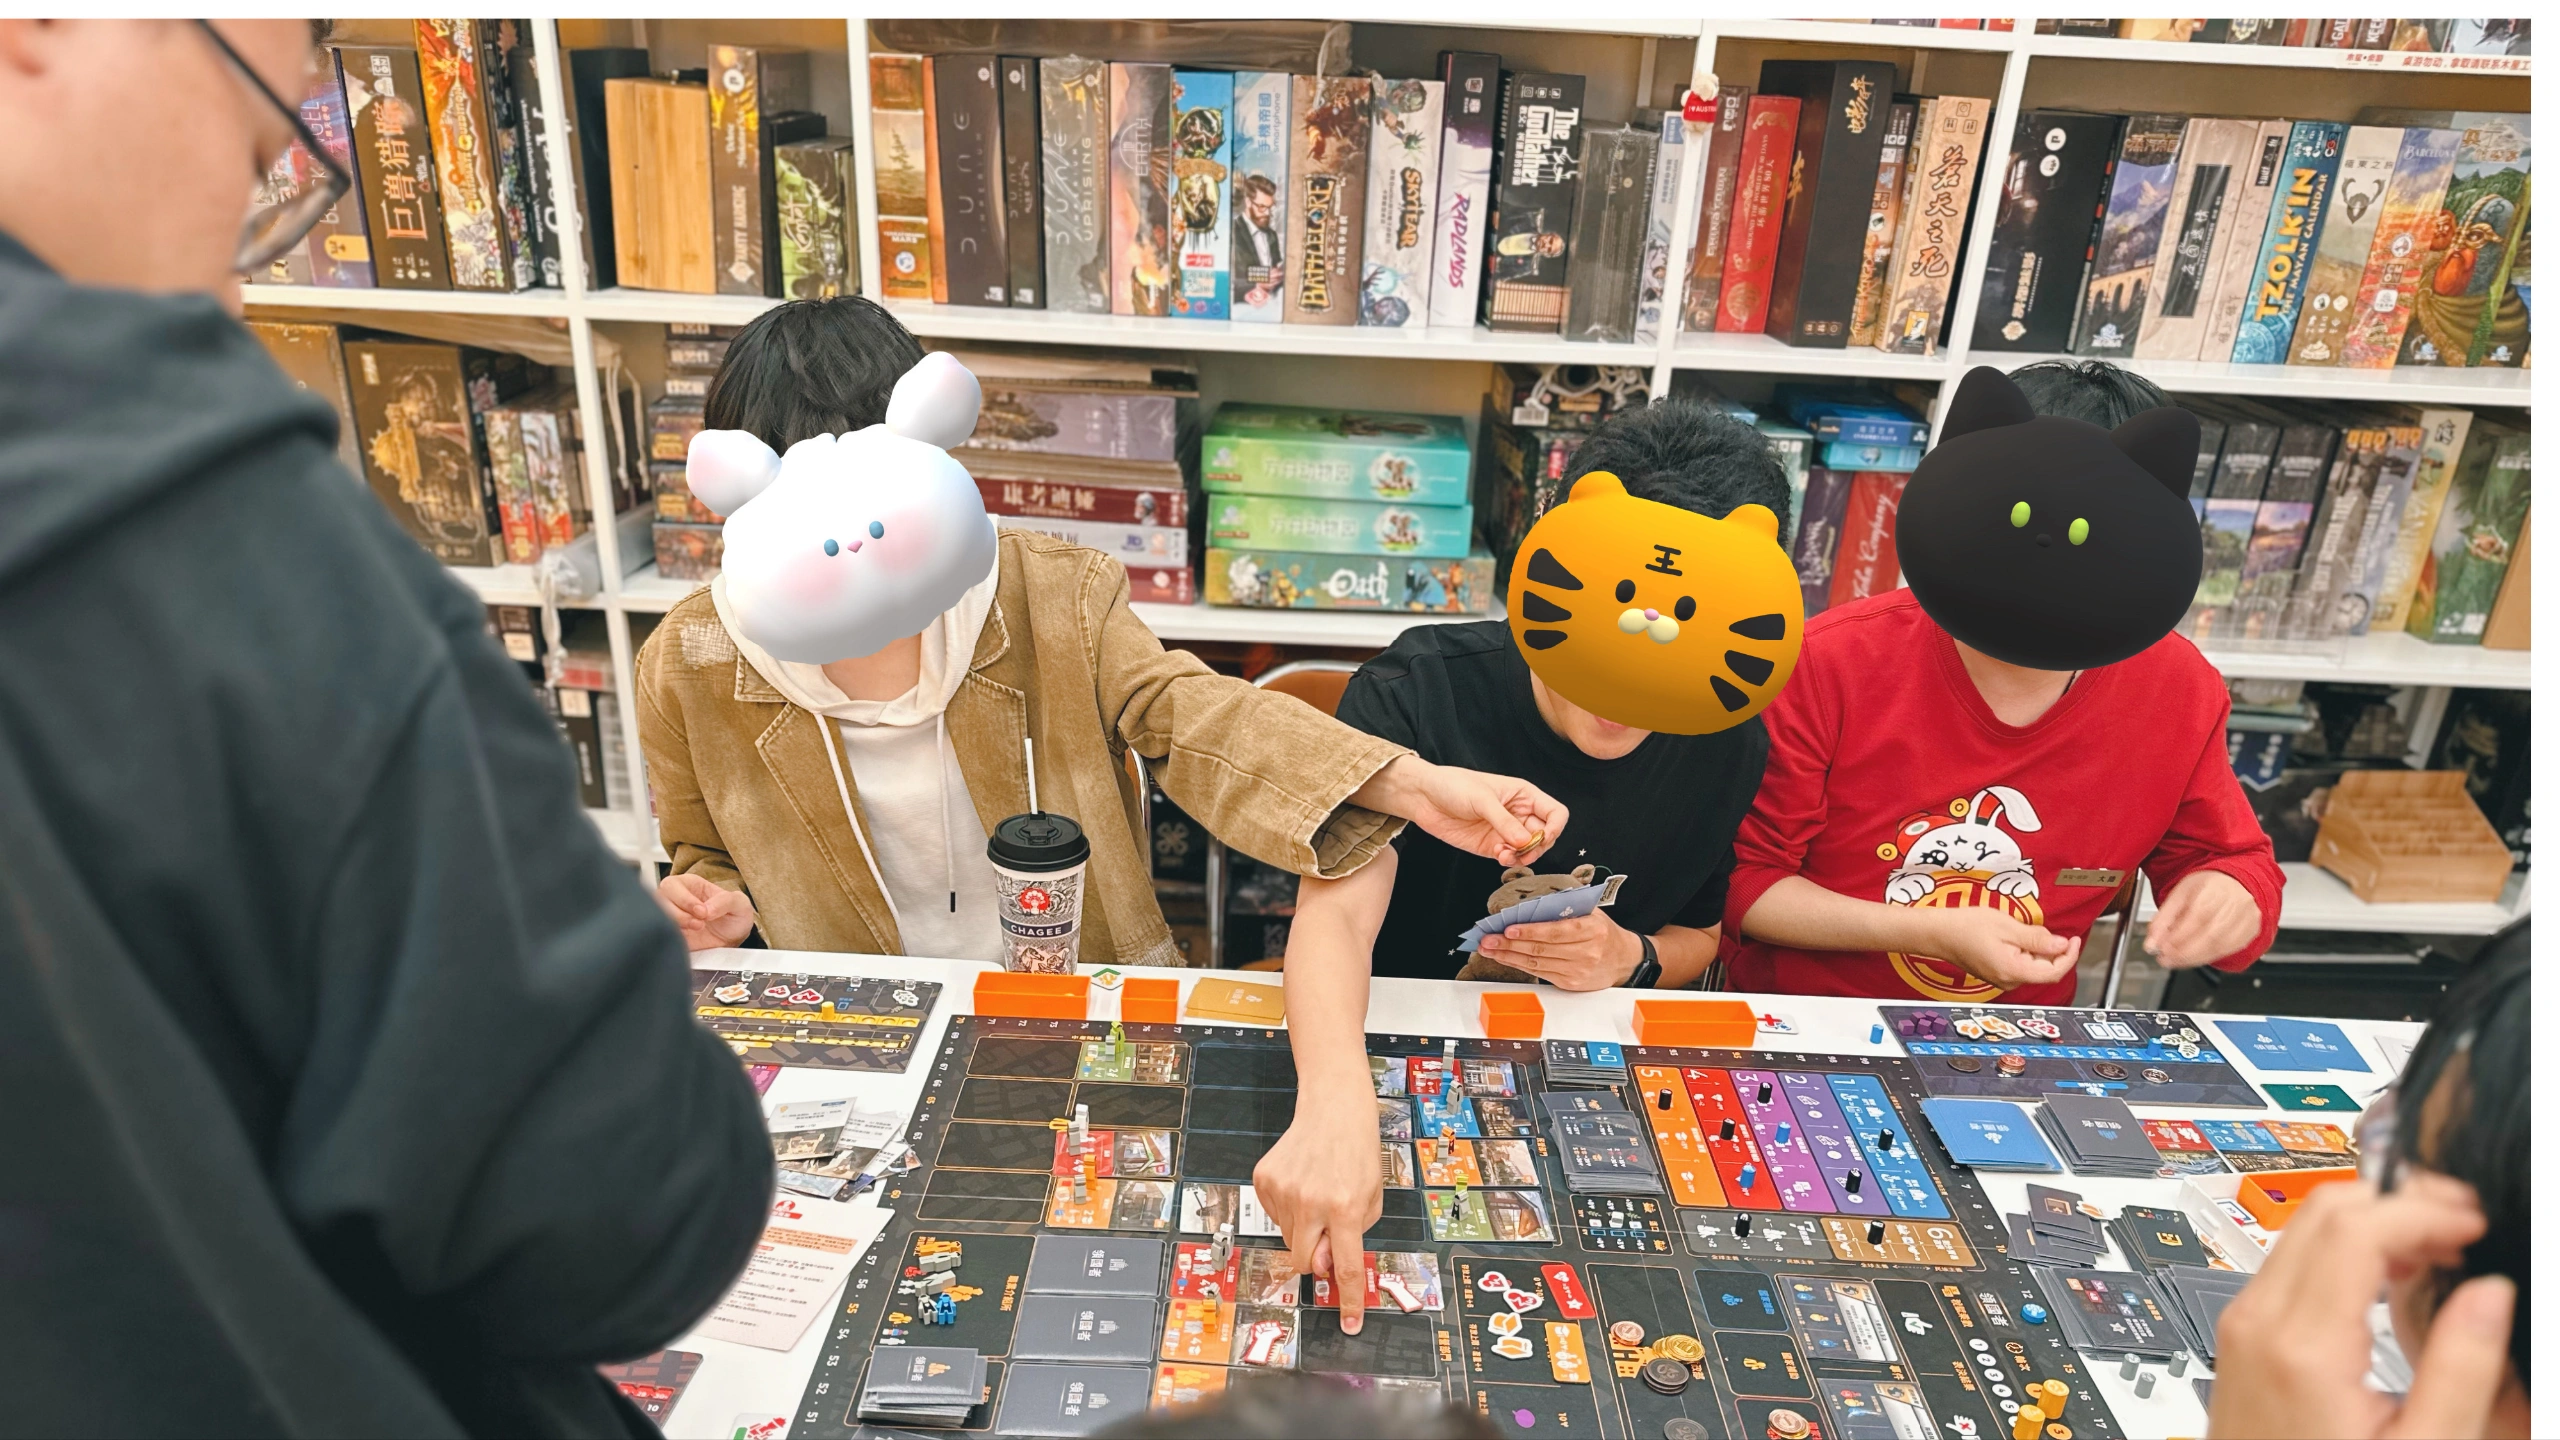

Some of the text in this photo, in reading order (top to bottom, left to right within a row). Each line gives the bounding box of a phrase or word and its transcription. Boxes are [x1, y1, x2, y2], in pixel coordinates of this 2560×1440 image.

[1552, 107, 1580, 141] The
[1134, 117, 1150, 177] EARTH
[1520, 105, 1555, 188] Godfather
[1081, 136, 1094, 242] UPRISING
[1400, 168, 1423, 249] SKYTEAR
[891, 235, 918, 244] MARS
[1448, 192, 1472, 289] RADLANDS
[1747, 220, 1757, 250] AROUND
[1302, 178, 1337, 308] BATTLELORE
[2254, 167, 2318, 322] TZOLK'IN
[2280, 173, 2329, 315] THE MAYAN CALENDAR
[1858, 494, 1900, 563] Company
[1320, 561, 1391, 606] Oath
[1010, 923, 1063, 936] CHAGEE
[1081, 1022, 1089, 1030] 74
[1204, 1027, 1212, 1035] 78
[950, 1031, 959, 1039] 69
[1265, 1029, 1274, 1038] 80
[1420, 1037, 1429, 1045] 85
[945, 1048, 954, 1056] 68
[1638, 1047, 1647, 1055] 92
[1701, 1050, 1710, 1058] 94
[1733, 1051, 1742, 1059] 95
[1764, 1052, 1774, 1060] 96
[1796, 1054, 1806, 1062] 97
[1828, 1055, 1837, 1063] 98
[940, 1063, 949, 1071] 67
[1640, 1068, 1663, 1077] 5
[1687, 1069, 1708, 1080] 4
[1735, 1072, 1759, 1082] 3
[1784, 1075, 1808, 1084] 2
[932, 1079, 942, 1087] 66
[926, 1096, 936, 1105] 65
[919, 1114, 930, 1122] 64
[913, 1131, 923, 1140] 63
[890, 1189, 901, 1199] 60
[1788, 1220, 1816, 1232] 7
[1927, 1226, 1954, 1240] 6
[1996, 1244, 2008, 1254] 10
[865, 1255, 877, 1265] 57
[1088, 1249, 1106, 1278] 領國者
[2009, 1267, 2020, 1276] 11
[857, 1278, 868, 1289] 56
[2020, 1289, 2032, 1299] 12
[846, 1302, 860, 1314] 55
[1978, 1291, 2009, 1329] 領國者
[1076, 1310, 1095, 1342] 領國者
[837, 1328, 850, 1339] 54
[2047, 1337, 2060, 1348] 14
[827, 1354, 840, 1367] 53
[911, 1355, 927, 1382] 領國者
[2062, 1363, 2074, 1375] 15
[817, 1382, 830, 1394] 52
[1064, 1381, 1084, 1417] 領國者
[2077, 1390, 2091, 1402] 16
[646, 1403, 660, 1412] 10
[805, 1411, 819, 1423] 51
[2092, 1417, 2106, 1430] 17
